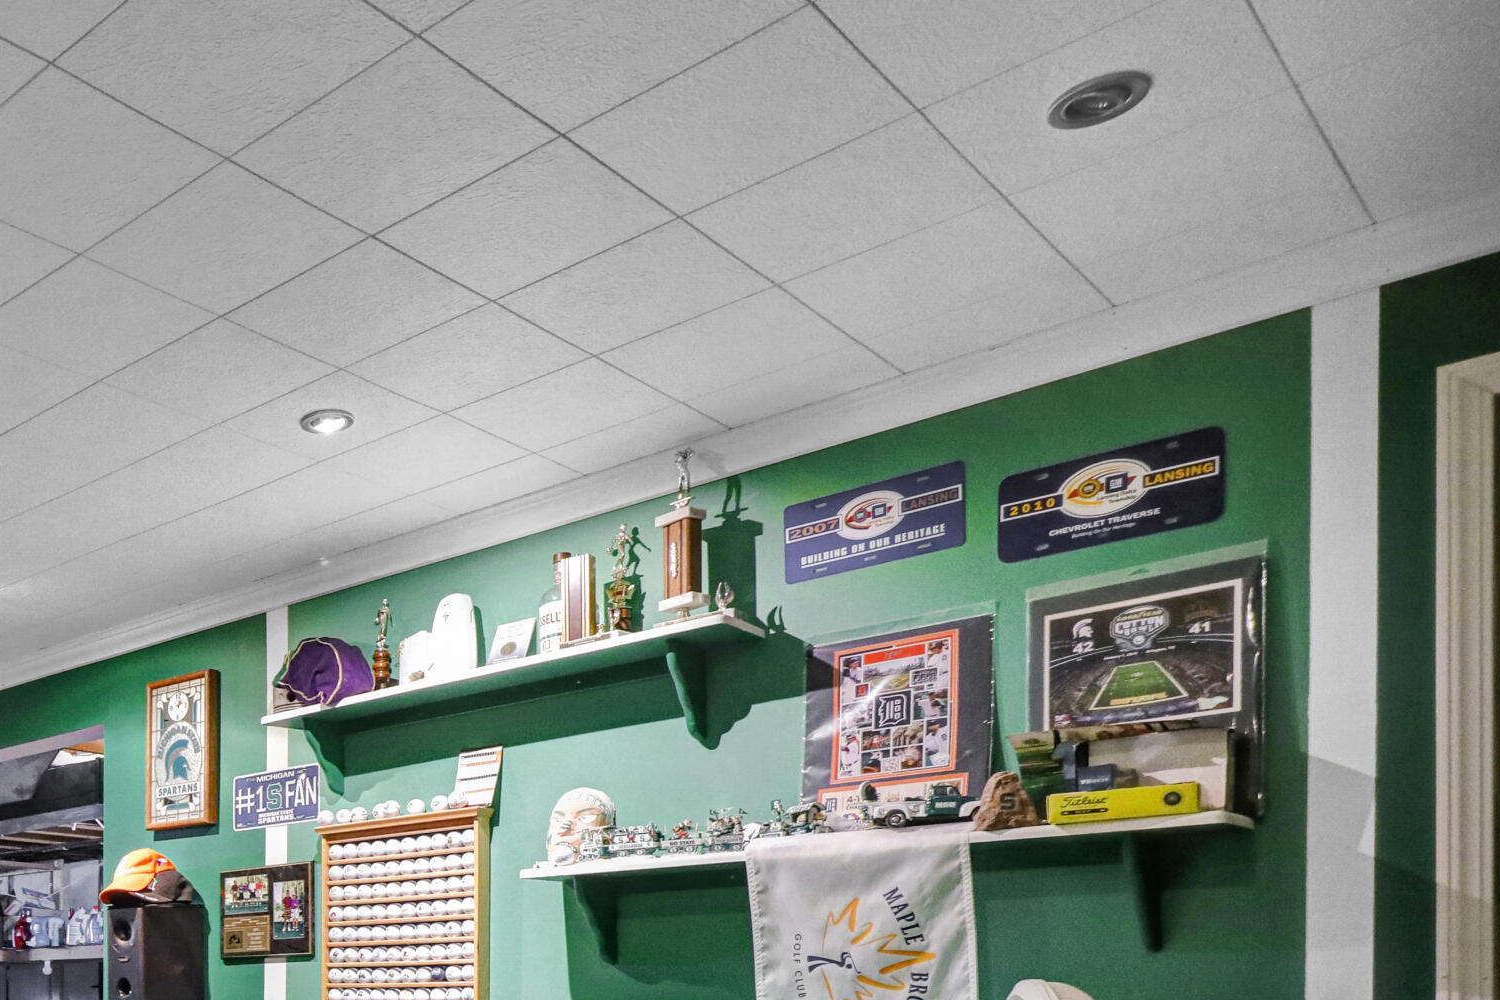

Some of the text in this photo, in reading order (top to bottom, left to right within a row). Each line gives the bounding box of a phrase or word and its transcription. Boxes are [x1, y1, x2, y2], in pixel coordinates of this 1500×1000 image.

[1009, 462, 1214, 516] 2010 LANSING
[790, 487, 958, 540] 2007 LANSING
[1048, 507, 1162, 537] CHEVROLET TRAVERSE
[800, 523, 946, 566] BUILDING ON OUR HERITAGE
[1188, 620, 1212, 634] 41
[1072, 641, 1095, 654] 42
[158, 782, 198, 797] SPARTANS
[256, 770, 295, 783] MICHIGAN
[285, 773, 317, 809] FAN
[257, 814, 295, 825] SPARTANS
[883, 886, 925, 946] MAPLE
[792, 933, 807, 999] GOLF CLUB
